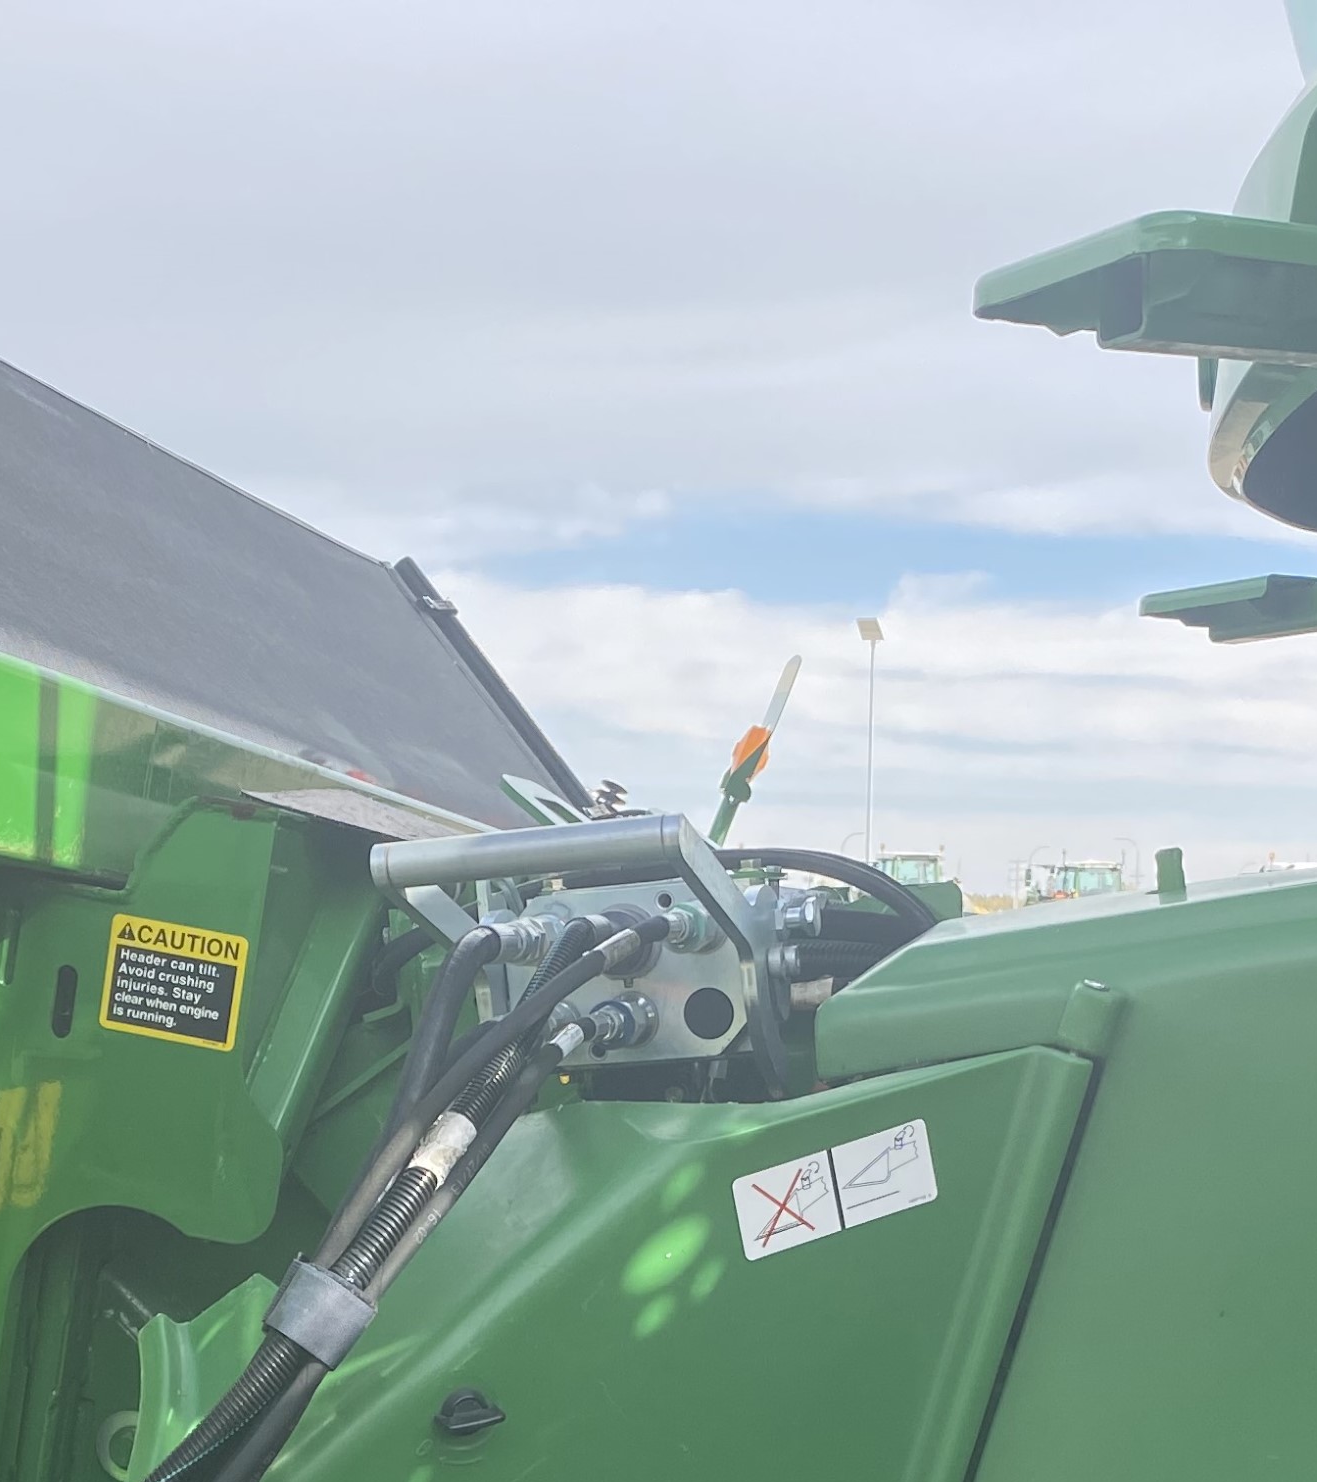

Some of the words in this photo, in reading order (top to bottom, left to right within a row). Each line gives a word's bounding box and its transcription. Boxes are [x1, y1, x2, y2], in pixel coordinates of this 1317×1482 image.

[137, 925, 240, 960] CAUTION
[121, 948, 167, 966] Header
[171, 960, 194, 972] can
[199, 964, 219, 977] tilt.
[117, 976, 167, 996] injuries.
[172, 987, 201, 1004] Stay
[119, 963, 155, 979] Avoid
[159, 972, 214, 993] crushing
[113, 1004, 123, 1015] is
[127, 1009, 176, 1028] running.
[115, 992, 144, 1005] clear
[146, 998, 177, 1011] when
[179, 1003, 219, 1020] engine
